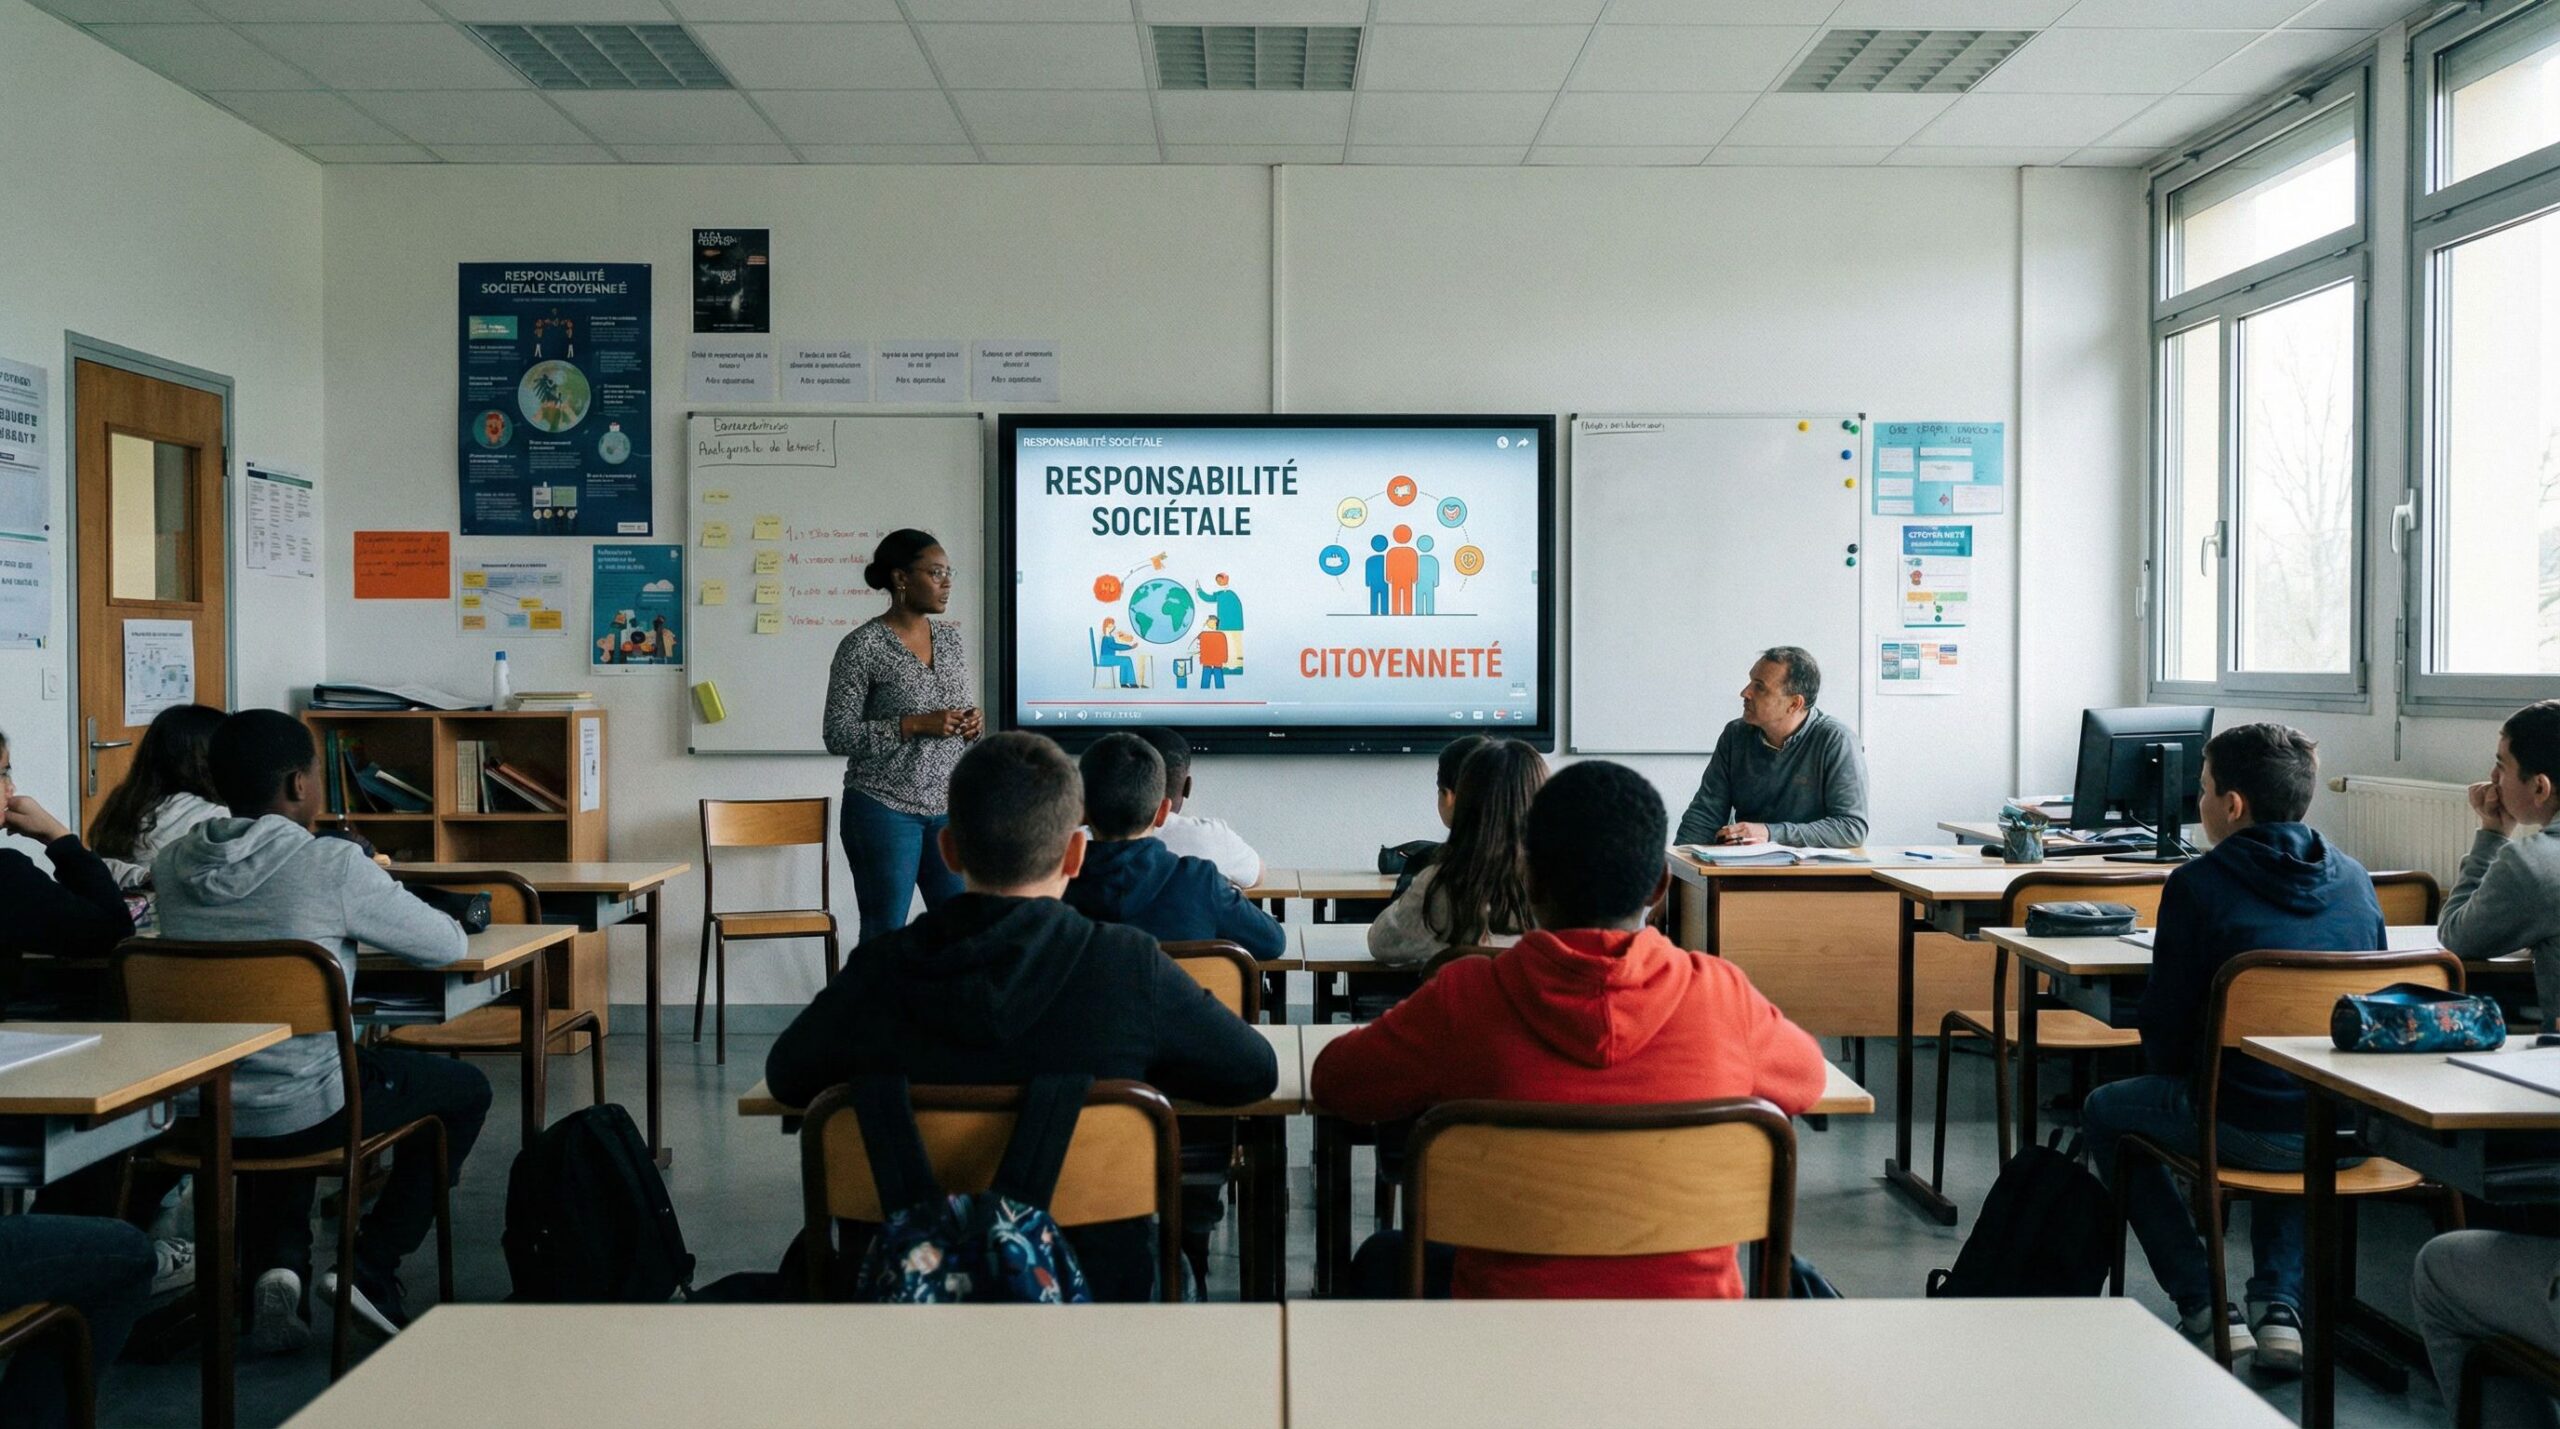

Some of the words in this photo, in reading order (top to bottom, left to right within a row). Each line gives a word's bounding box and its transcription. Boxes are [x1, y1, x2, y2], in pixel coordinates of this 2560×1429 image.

[505, 268, 605, 282] RESPONSABILITÉ
[481, 283, 546, 294] SOCIETALE
[1023, 435, 1107, 448] RESPONSABILITÉ
[1046, 458, 1298, 495] RESPONSABILITÉ
[1092, 499, 1251, 536] SOCIÉTALE
[1300, 640, 1503, 678] CITOYENNETÉ
